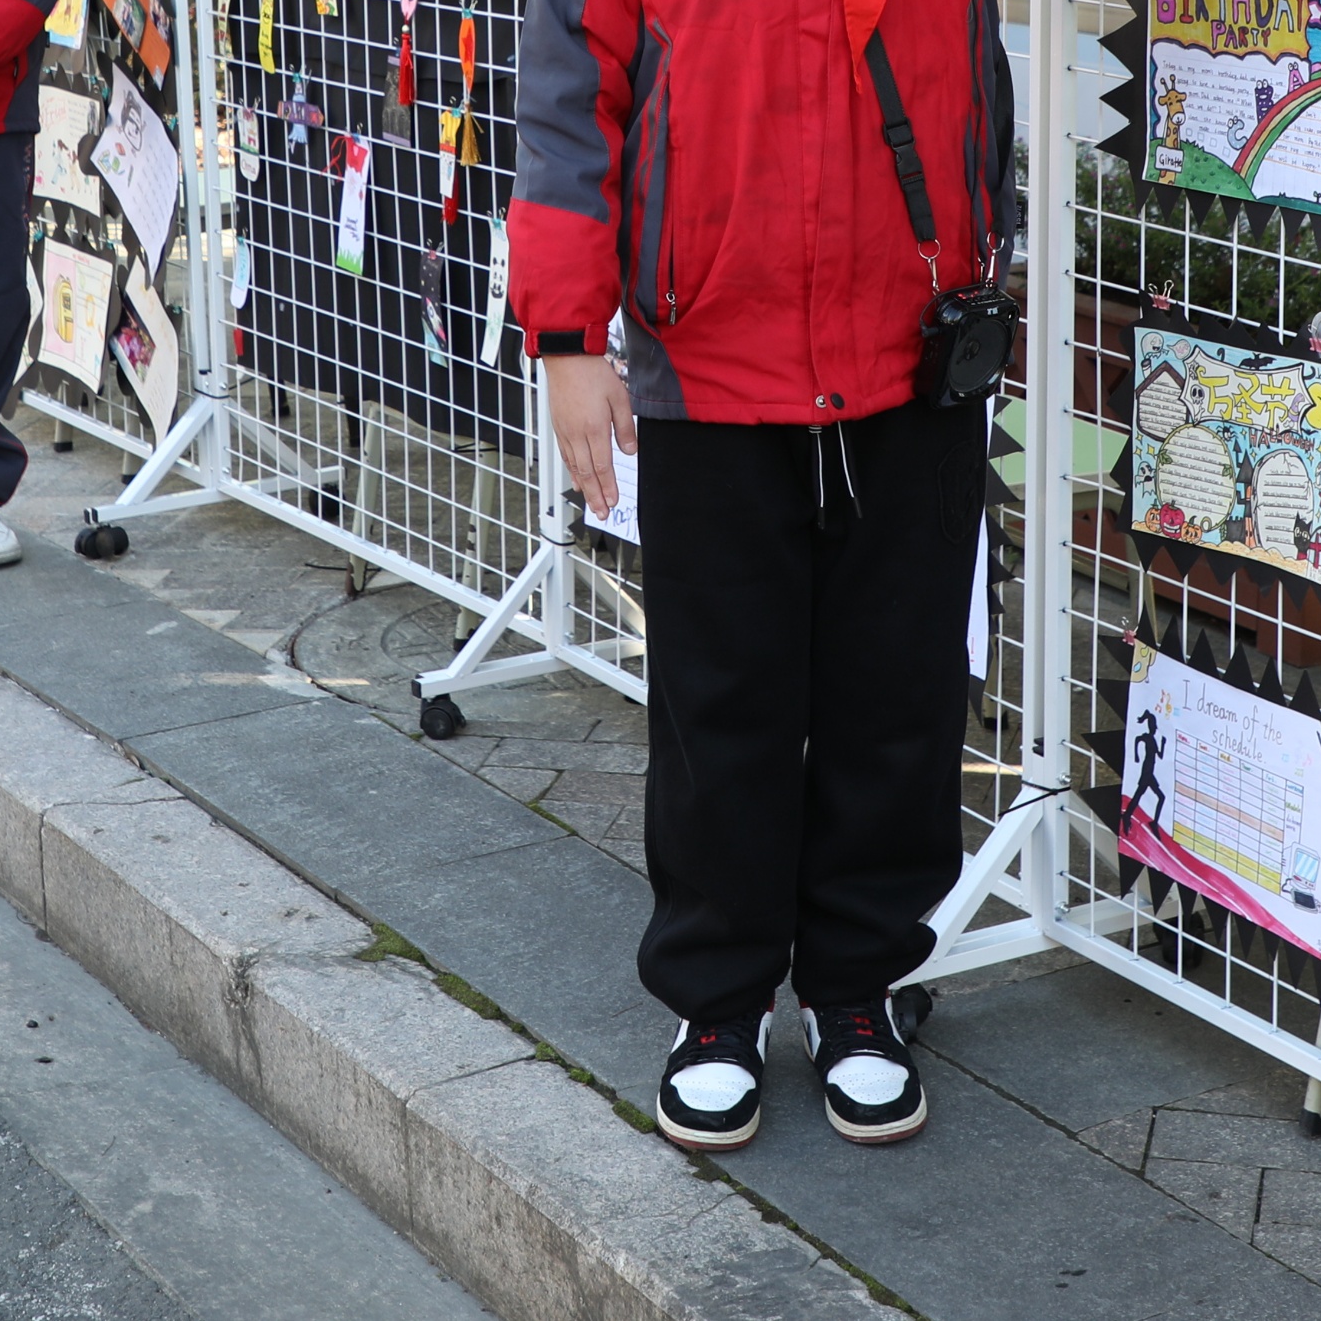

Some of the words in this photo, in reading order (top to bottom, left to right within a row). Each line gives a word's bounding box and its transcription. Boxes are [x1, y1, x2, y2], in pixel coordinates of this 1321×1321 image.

[1211, 20, 1271, 50] PARTY
[1182, 679, 1192, 712] I
[1197, 682, 1238, 724] dream
[1243, 704, 1260, 742] of
[1263, 713, 1283, 746] the
[1212, 725, 1267, 765] schedule.
